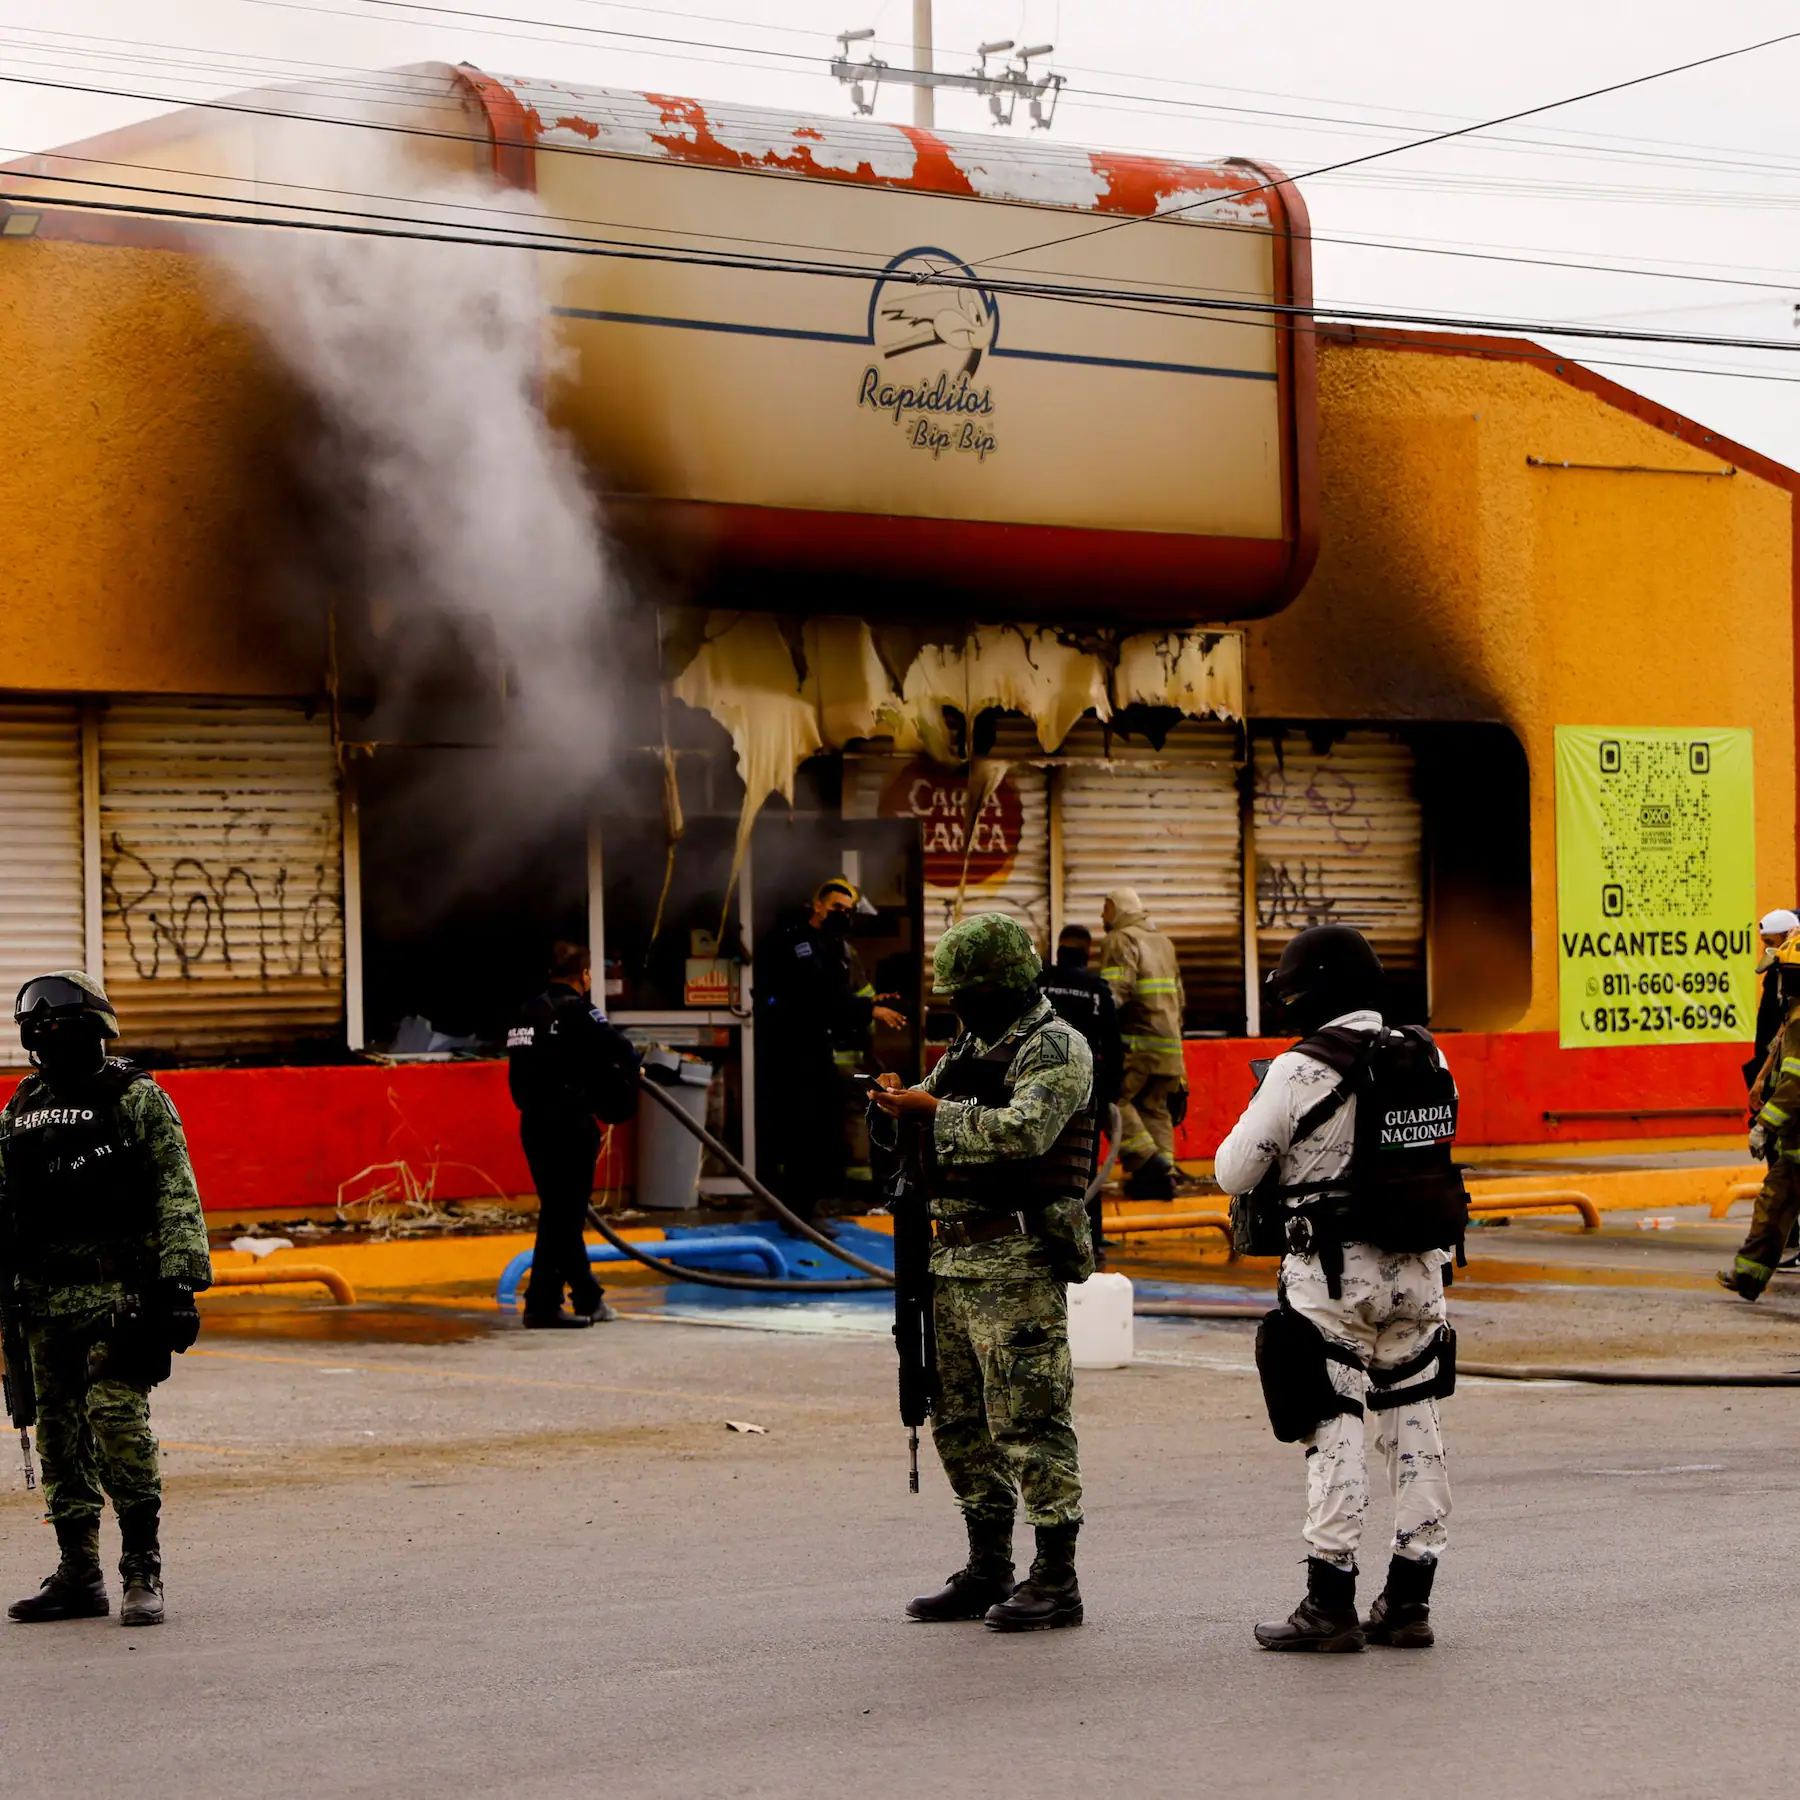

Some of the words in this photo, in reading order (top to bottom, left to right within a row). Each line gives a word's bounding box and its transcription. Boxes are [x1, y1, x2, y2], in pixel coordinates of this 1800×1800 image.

[859, 367, 993, 422] Rapiditos
[912, 418, 951, 458] Bip
[958, 421, 996, 461] Bip
[908, 778, 1003, 816] CARA
[1640, 806, 1670, 826] OXXO
[900, 817, 1008, 853] LANCA
[1562, 931, 1688, 957] VACANTES
[1694, 923, 1752, 960] AQUÍ
[1602, 971, 1730, 996] 811-660-6996
[1594, 1004, 1737, 1032] 813-231-6996
[26, 1118, 76, 1130] MEXICANO
[1385, 1105, 1452, 1126] GUARDIA
[1380, 1121, 1454, 1143] NACIONAL
